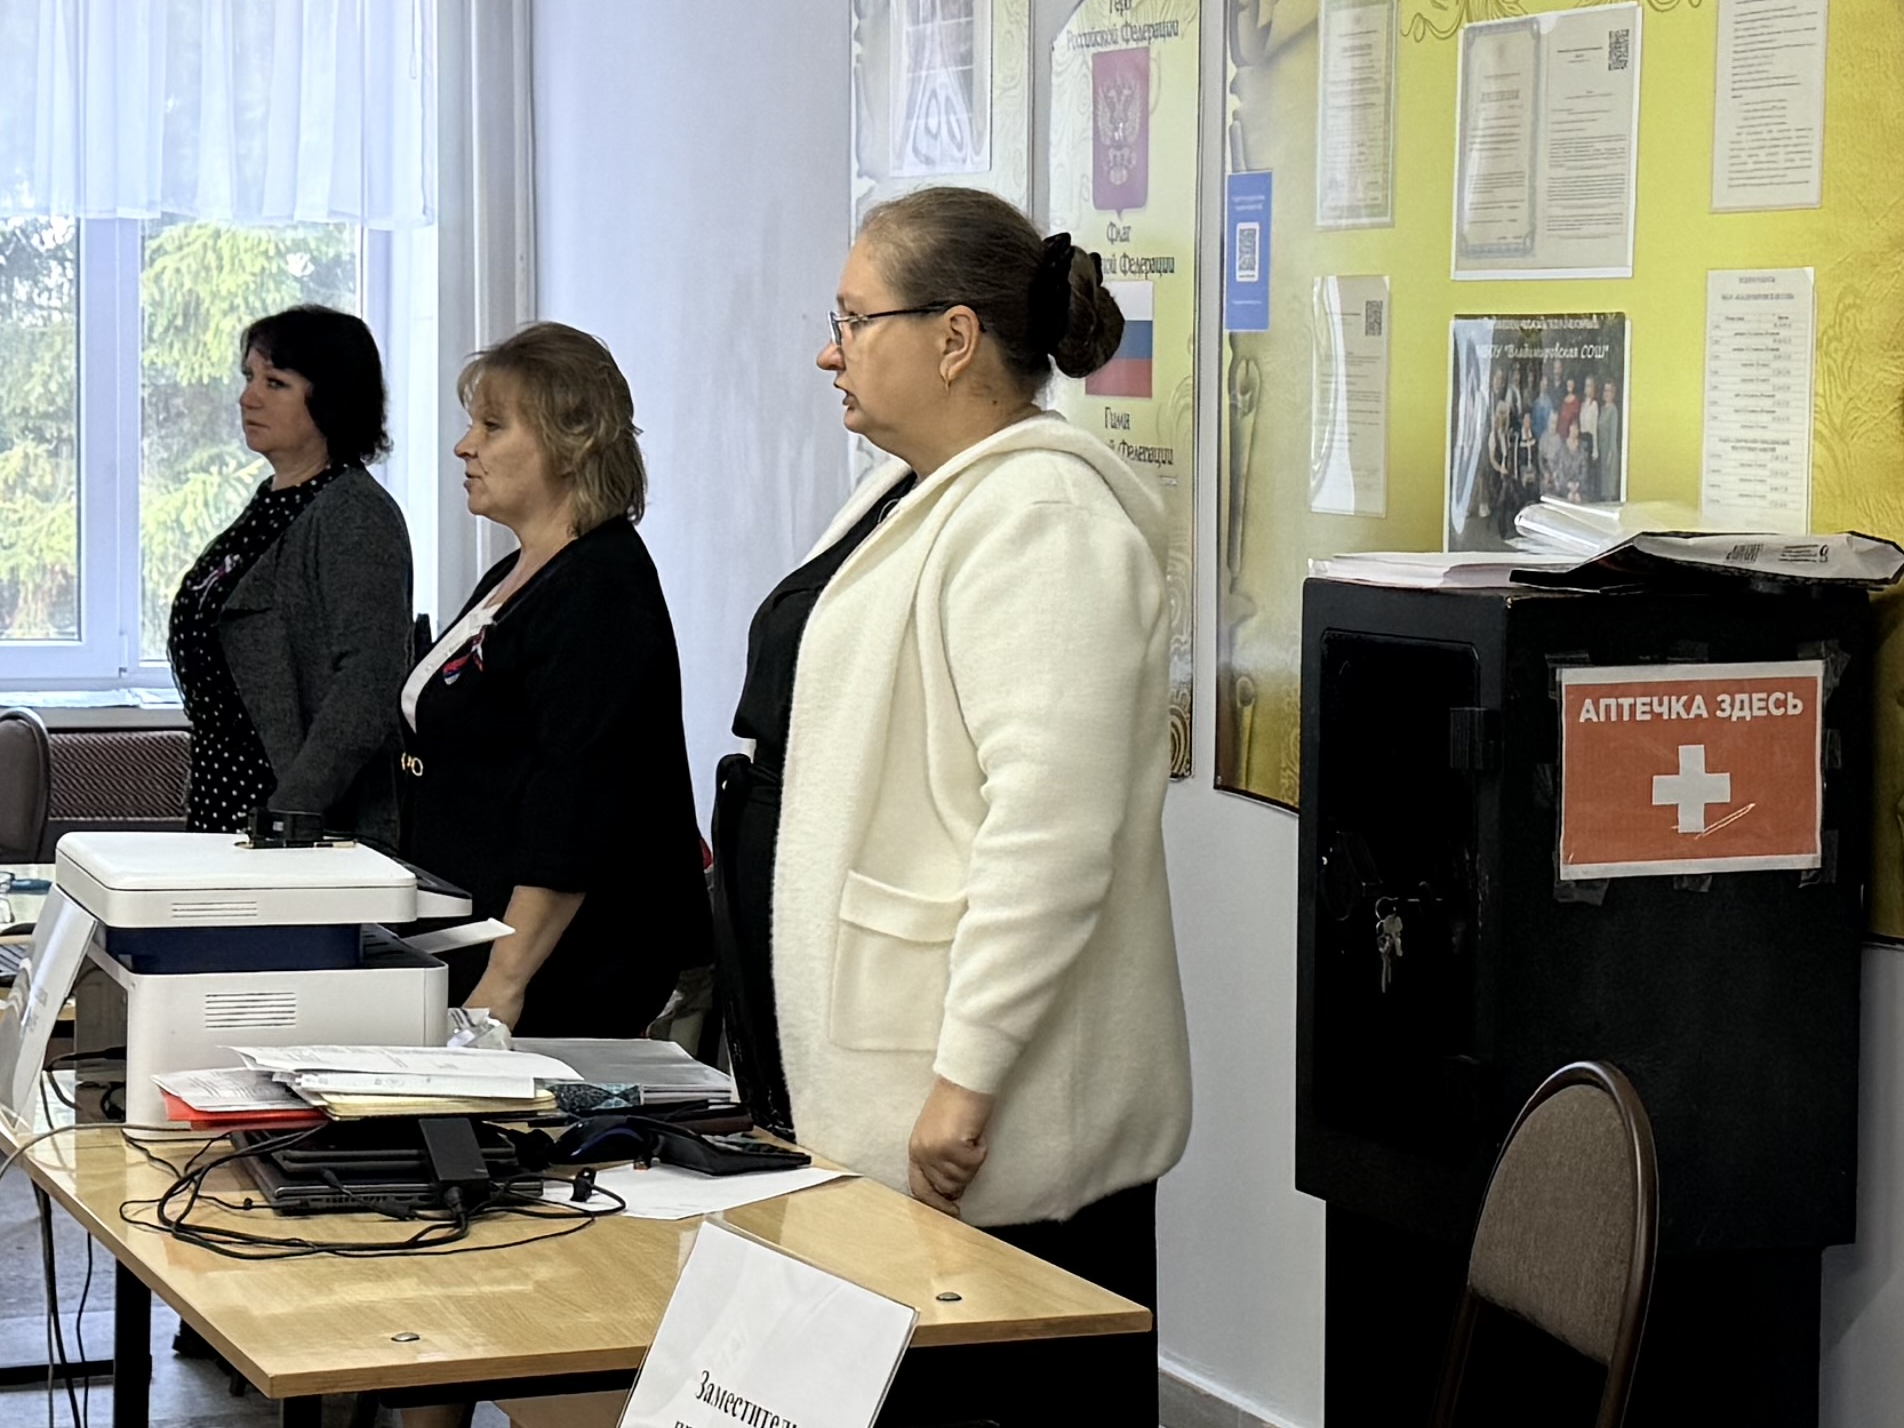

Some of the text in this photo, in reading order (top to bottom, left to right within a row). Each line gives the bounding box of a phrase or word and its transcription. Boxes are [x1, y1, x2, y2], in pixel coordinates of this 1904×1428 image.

[1119, 253, 1175, 279] Федерации
[1579, 691, 1803, 722] АПТЕЧКА ЗДЕСЬ
